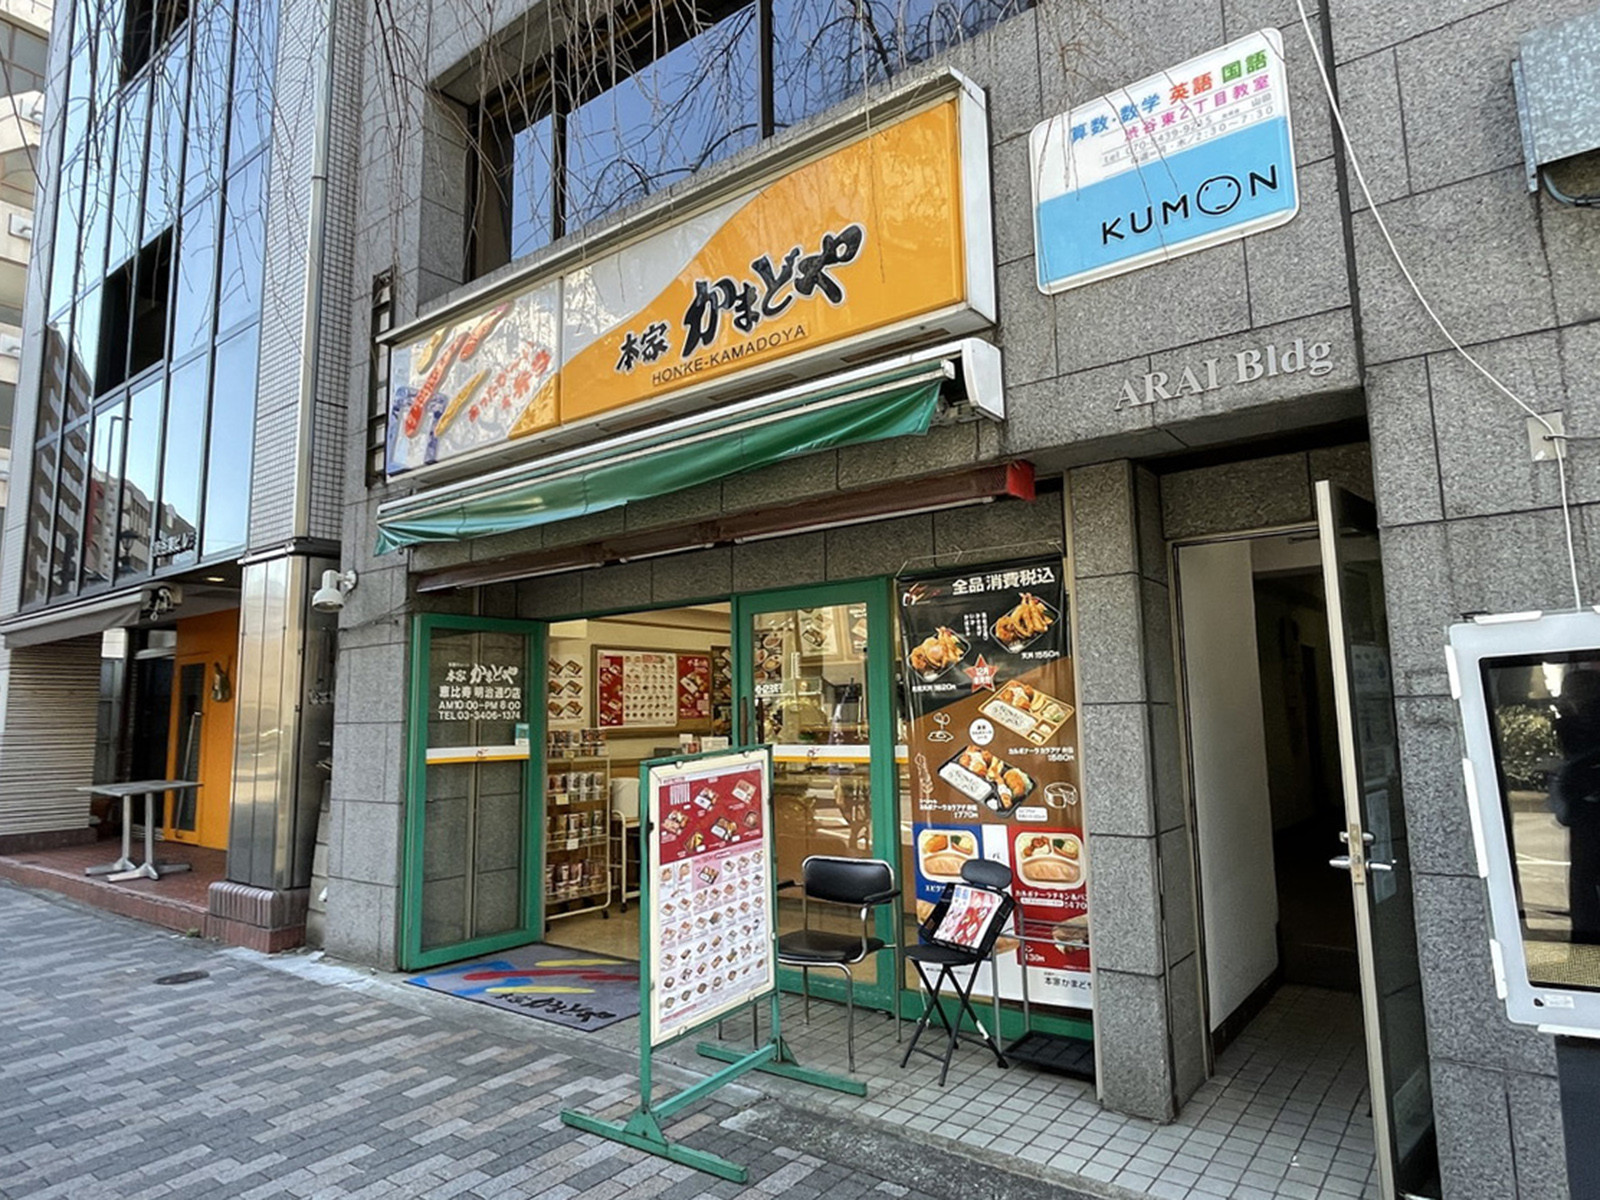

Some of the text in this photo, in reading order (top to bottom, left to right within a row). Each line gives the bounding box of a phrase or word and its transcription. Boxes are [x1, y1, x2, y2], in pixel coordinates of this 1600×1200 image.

[1168, 71, 1213, 104] 英語
[1221, 49, 1268, 83] 国語
[1102, 165, 1278, 245] KUMON
[616, 225, 863, 371] 本家 かまどや
[652, 325, 807, 384] HONKE-KAMADOYA
[1114, 338, 1333, 411] ARAI Bldg
[952, 567, 1055, 595] 全品 消費税込
[470, 664, 519, 684] かまどや
